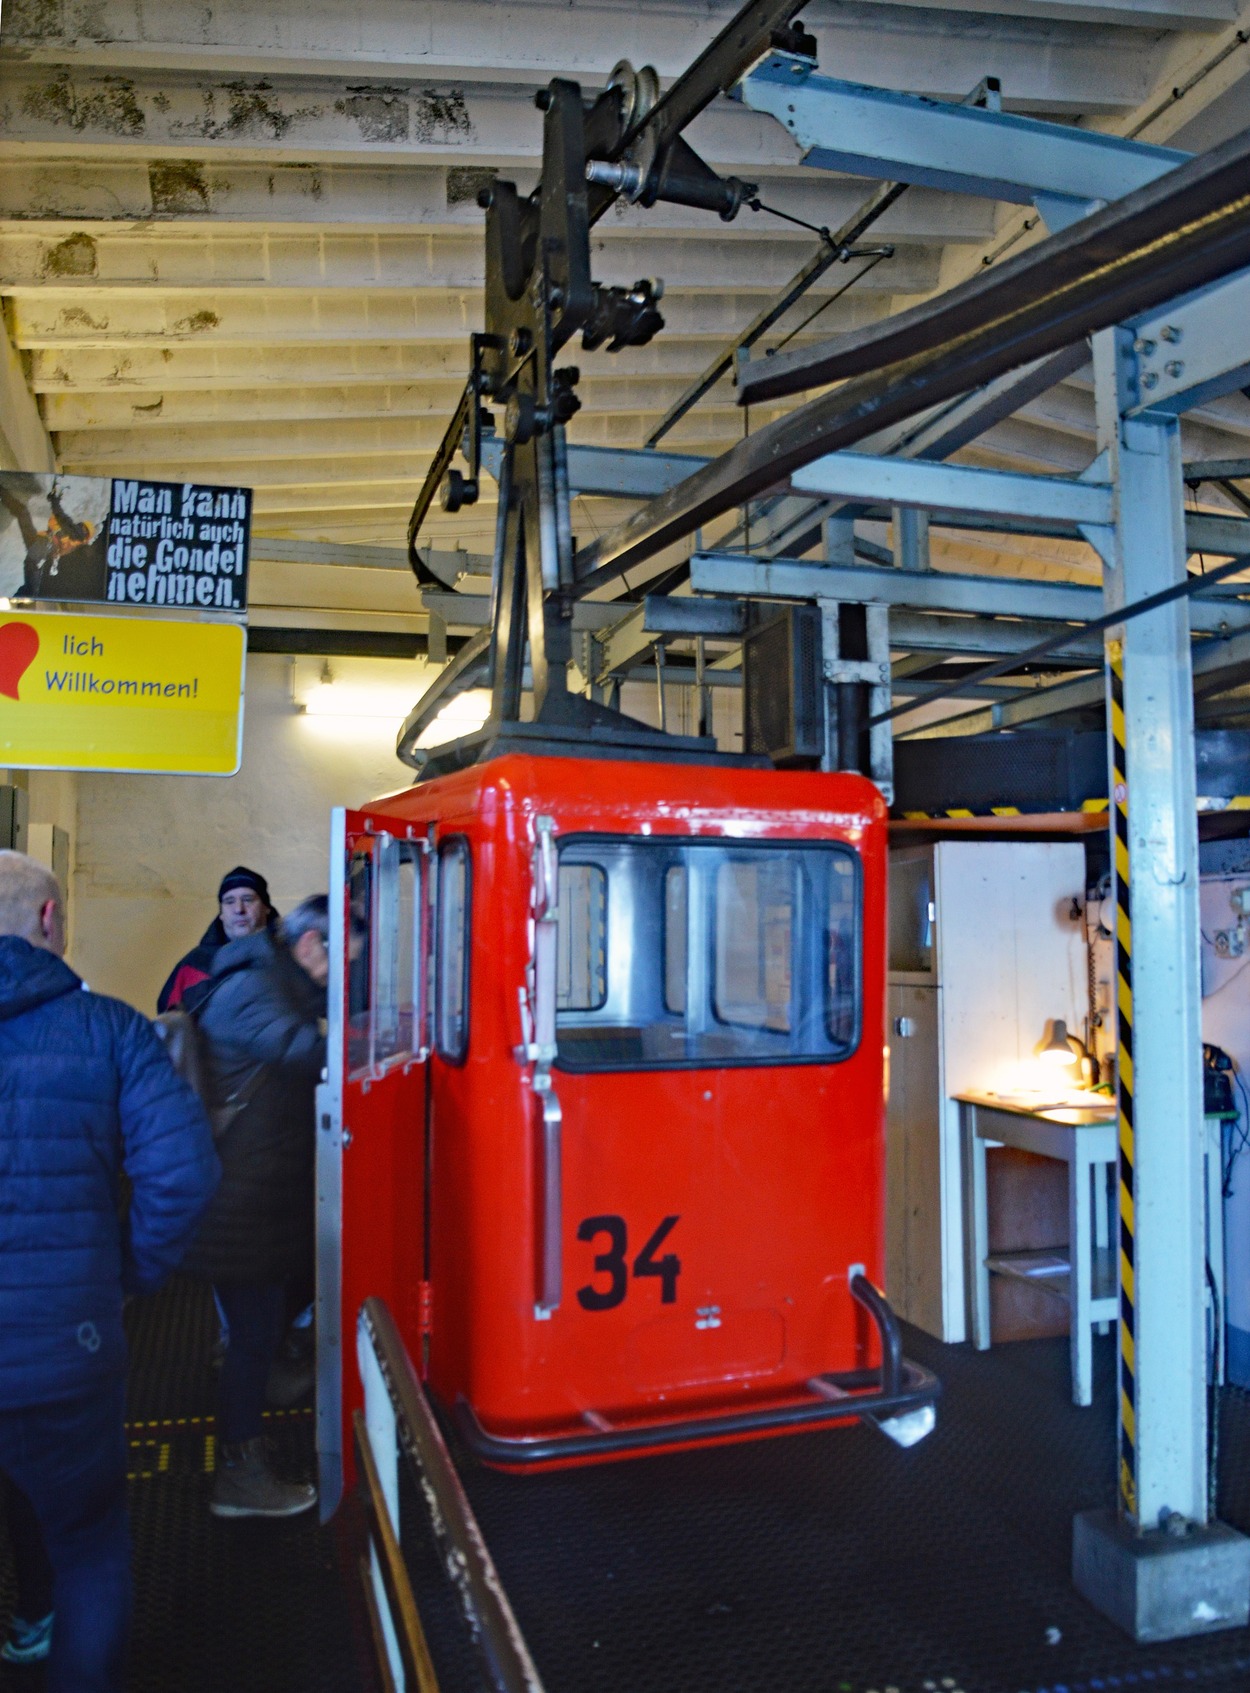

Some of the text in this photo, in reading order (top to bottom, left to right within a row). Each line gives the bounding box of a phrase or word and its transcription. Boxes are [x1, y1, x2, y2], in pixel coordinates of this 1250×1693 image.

[114, 480, 246, 520] Man kann
[110, 515, 245, 543] natürlich auch
[107, 537, 244, 576] die Gondel
[107, 564, 240, 608] nehmen.
[63, 634, 104, 656] lich
[45, 670, 199, 699] Willkommen!
[576, 1214, 682, 1312] 34
